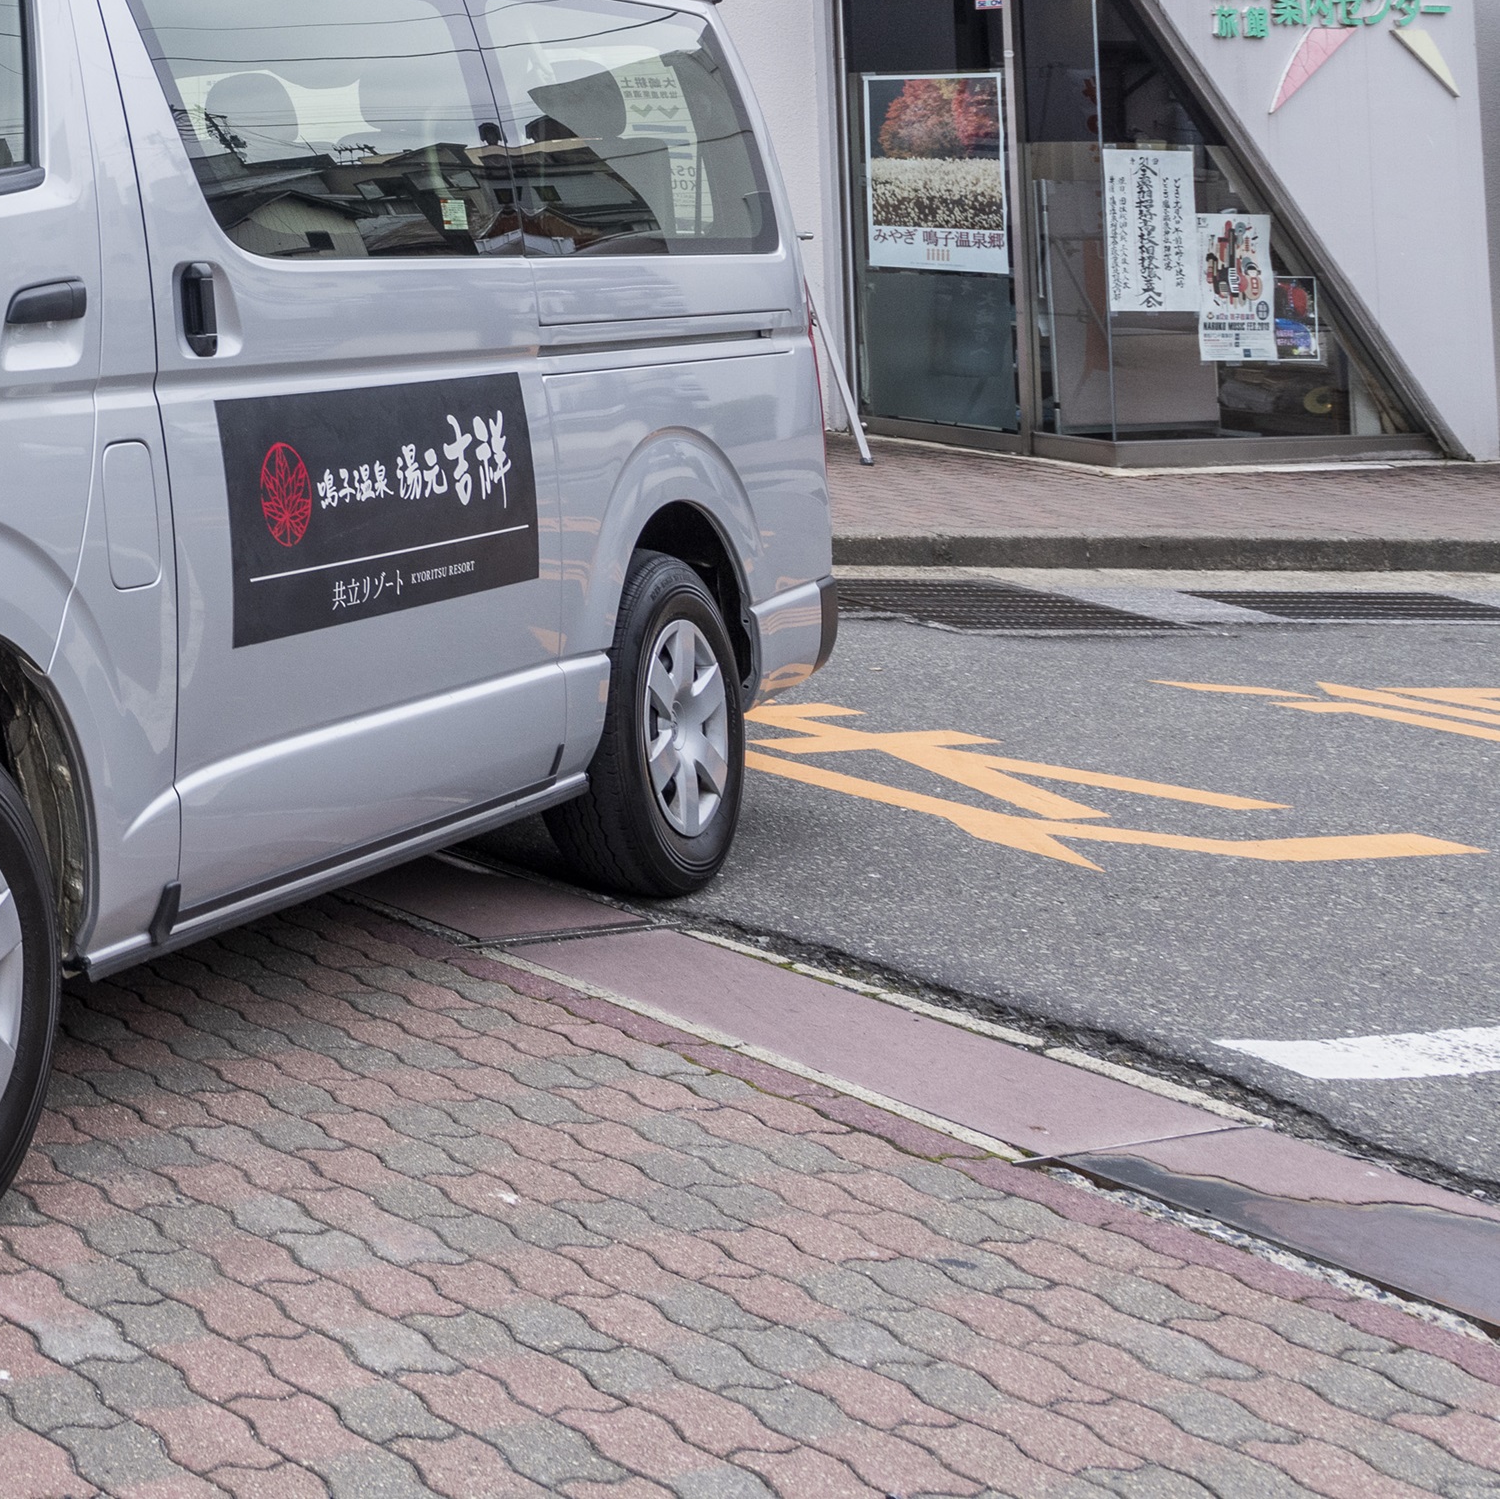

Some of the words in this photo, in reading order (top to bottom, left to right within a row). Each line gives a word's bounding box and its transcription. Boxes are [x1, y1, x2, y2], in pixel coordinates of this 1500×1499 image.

[1212, 5, 1269, 38] 旅館
[873, 228, 918, 245] みやぎ
[922, 230, 1005, 249] 鳴子温泉郷
[332, 569, 404, 611] 共立リゾート
[411, 565, 447, 585] KYORITSU
[448, 560, 475, 577] RESORT
